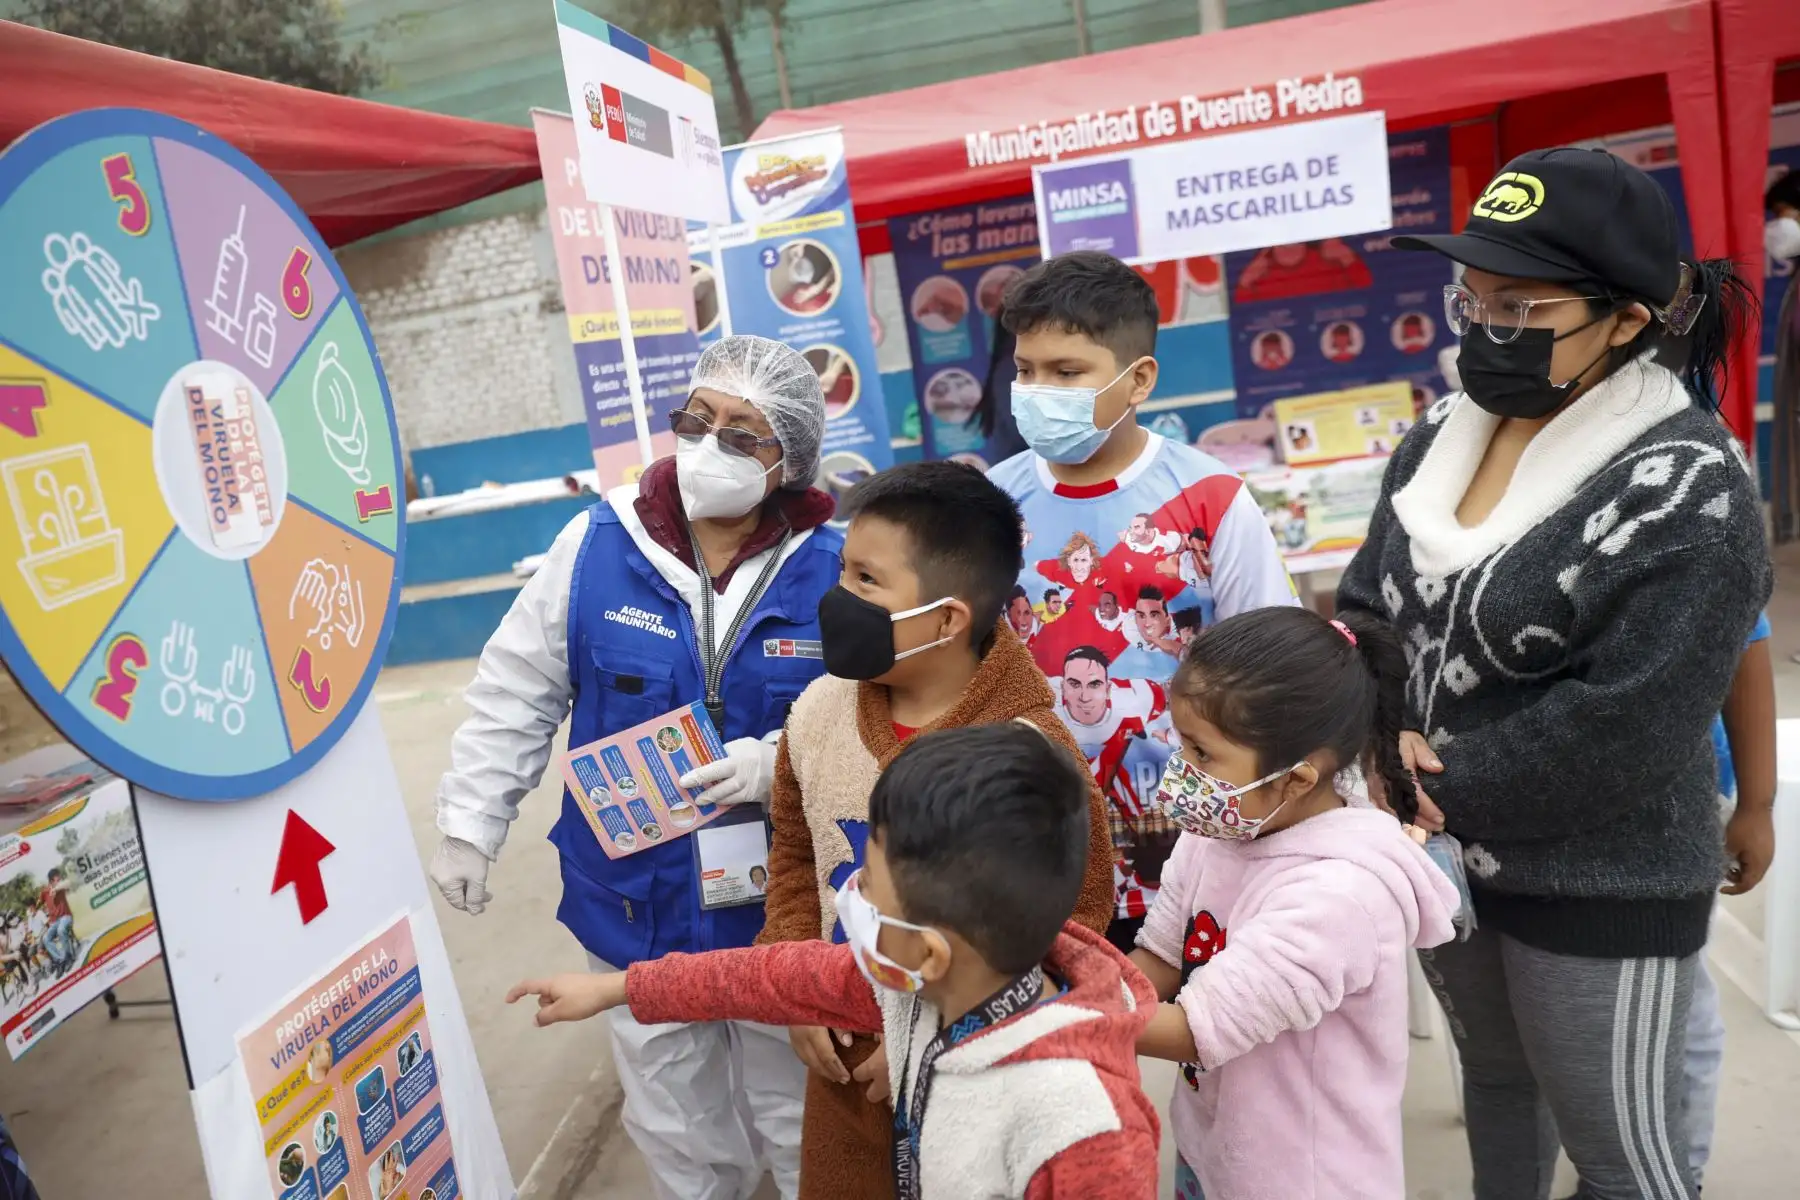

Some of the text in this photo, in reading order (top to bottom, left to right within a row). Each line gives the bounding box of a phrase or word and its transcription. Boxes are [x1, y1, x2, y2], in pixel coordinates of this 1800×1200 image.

[606, 104, 622, 123] PERÚ
[965, 71, 1364, 167] Municipalidad de Puente Piedra
[101, 152, 151, 235] 5
[1048, 181, 1128, 212] MINSA
[1176, 155, 1340, 198] ENTREGA DE
[558, 207, 590, 236] DE
[615, 209, 686, 243] VIRUELA
[1167, 185, 1355, 230] MASCARILLAS
[763, 251, 776, 266] 2
[932, 223, 1036, 257] las man
[281, 246, 312, 319] 6
[625, 256, 681, 284] MONO
[189, 389, 228, 524] DEL MONO
[211, 405, 239, 508] VIRUELA
[228, 423, 250, 490] DE LA
[355, 484, 393, 523] 1
[604, 610, 677, 639] COMUNITARIO
[620, 605, 663, 624] AGENTE
[91, 637, 148, 722] 3
[289, 645, 331, 713] 2
[122, 838, 136, 850] tos
[270, 958, 398, 1070] VIRUELA DEL MONO
[276, 947, 388, 1044] PROTÉGETE DE LA
[984, 984, 1029, 1025] PLAST
